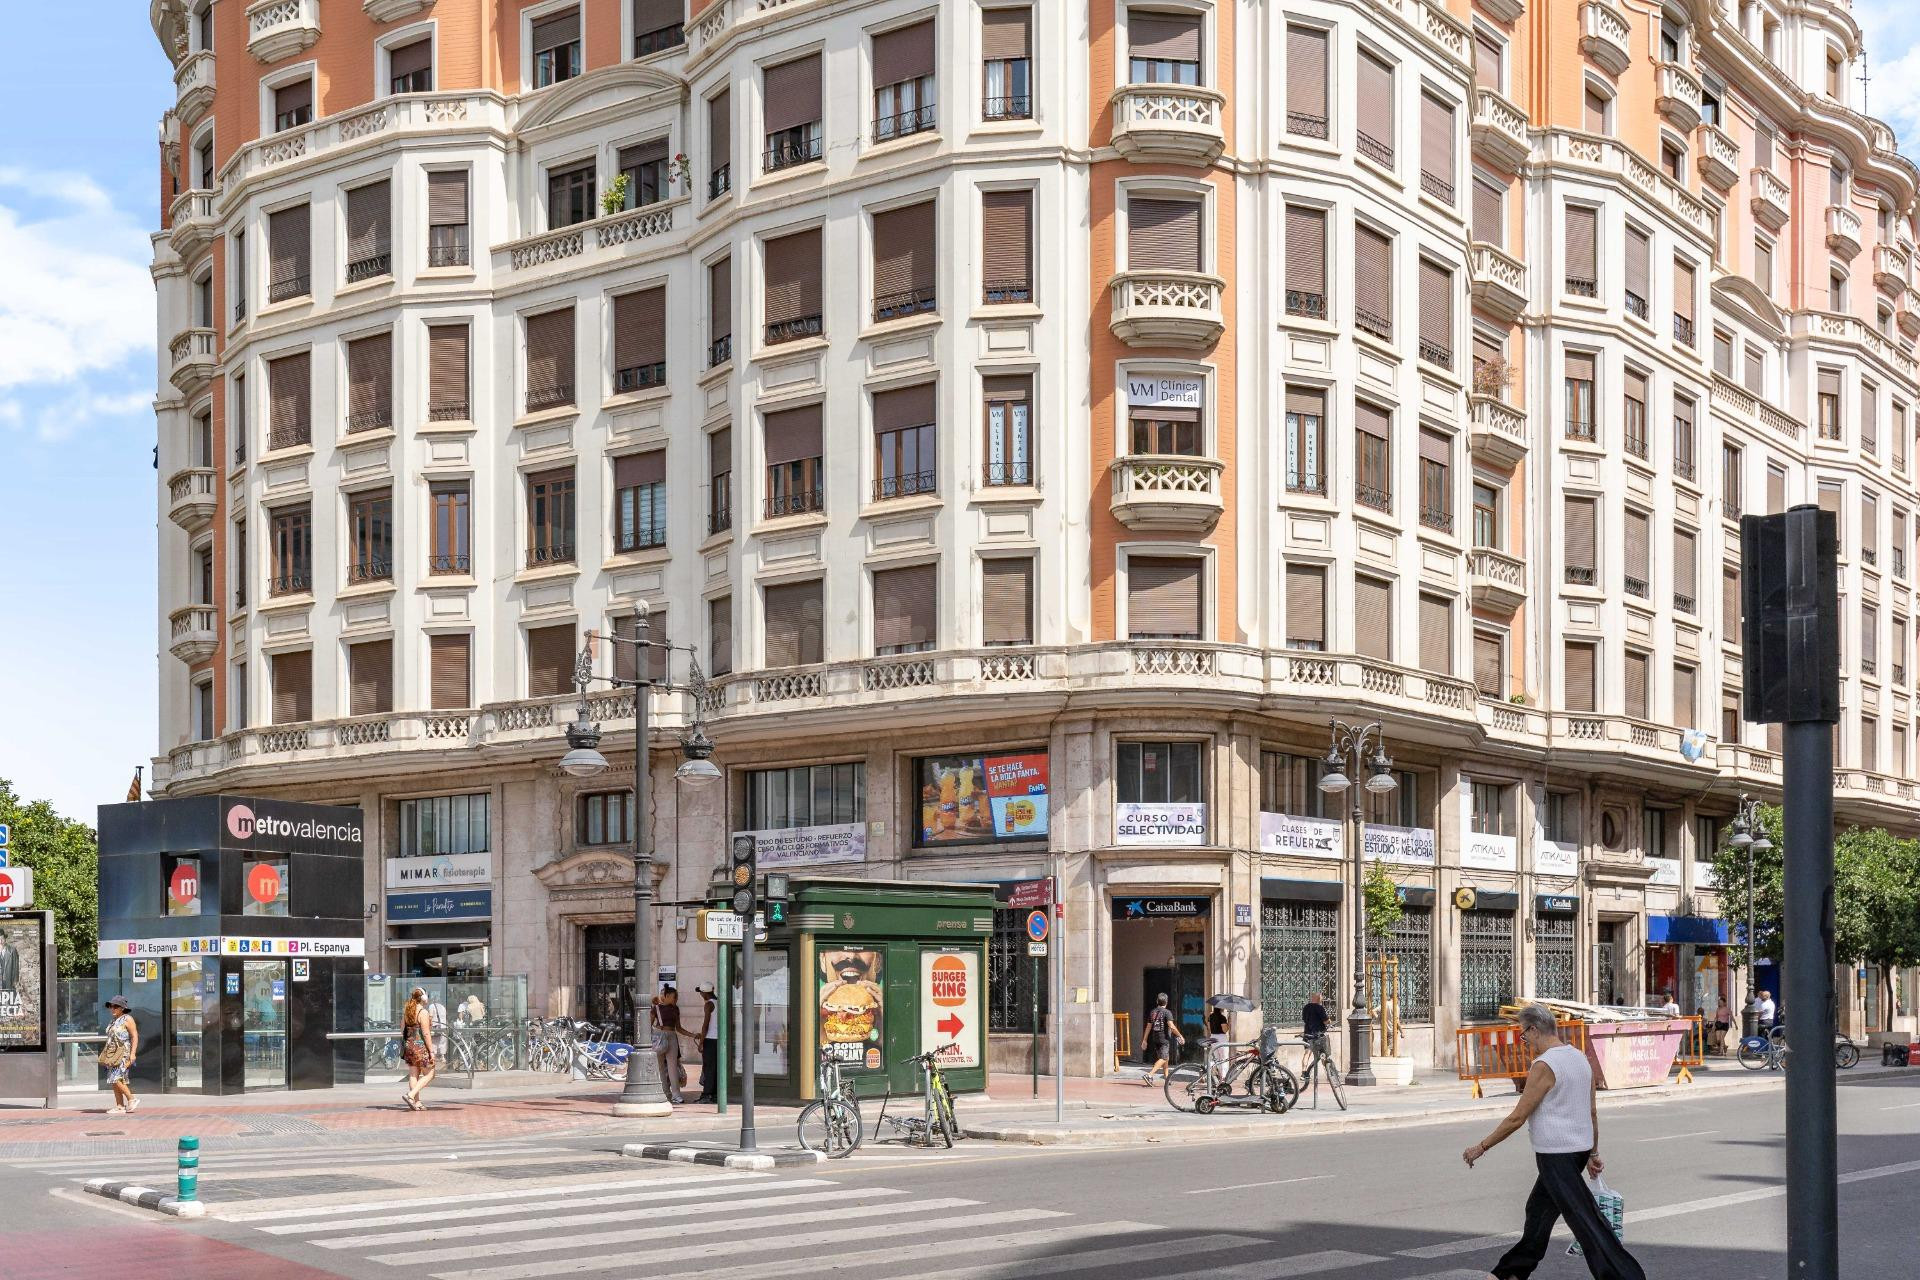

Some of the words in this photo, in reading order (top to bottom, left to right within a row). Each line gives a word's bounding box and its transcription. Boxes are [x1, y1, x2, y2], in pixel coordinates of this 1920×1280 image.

[1130, 383, 1154, 396] VM
[1161, 380, 1198, 391] Clínica
[1161, 391, 1197, 402] Dental
[989, 766, 996, 775] SE
[998, 765, 1006, 773] TE
[1007, 761, 1023, 771] HACE
[991, 773, 999, 782] LA
[1000, 771, 1017, 781] BOCA
[1126, 814, 1168, 823] CURSO
[1177, 814, 1193, 822] DE
[238, 815, 362, 843] metrovalencia
[1118, 825, 1205, 835] SELECTIVIDAD
[1281, 824, 1307, 835] CLASES
[1313, 828, 1323, 836] DE
[758, 838, 774, 846] ODO
[774, 837, 783, 845] DE
[784, 835, 813, 844] ESTUDIO
[817, 832, 853, 841] REFUERZO
[781, 843, 805, 851] CICLOS
[805, 839, 849, 849] FORMATIVOS
[1364, 833, 1389, 843] CURSOS
[1390, 836, 1399, 845] DE
[1401, 836, 1433, 848] MÉTODOS
[776, 849, 820, 858] VALENCIANO
[1364, 842, 1395, 855] ESTUDIO
[1401, 845, 1434, 858] MEMORIA
[401, 867, 438, 880] MIMAR
[443, 866, 485, 879] fisioterapia
[181, 878, 196, 896] m
[260, 878, 280, 897] m
[1146, 901, 1197, 912] CaixaBank
[936, 919, 967, 930] prensa
[138, 943, 147, 953] Pl.
[149, 943, 178, 955] Espanya
[300, 942, 312, 952] Pl.
[314, 942, 350, 954] Espanya
[932, 971, 966, 983] BURGER
[932, 982, 966, 997] KING
[0, 991, 22, 1005] PIA
[0, 1005, 24, 1017] ECTA
[834, 1042, 864, 1050] SOUR
